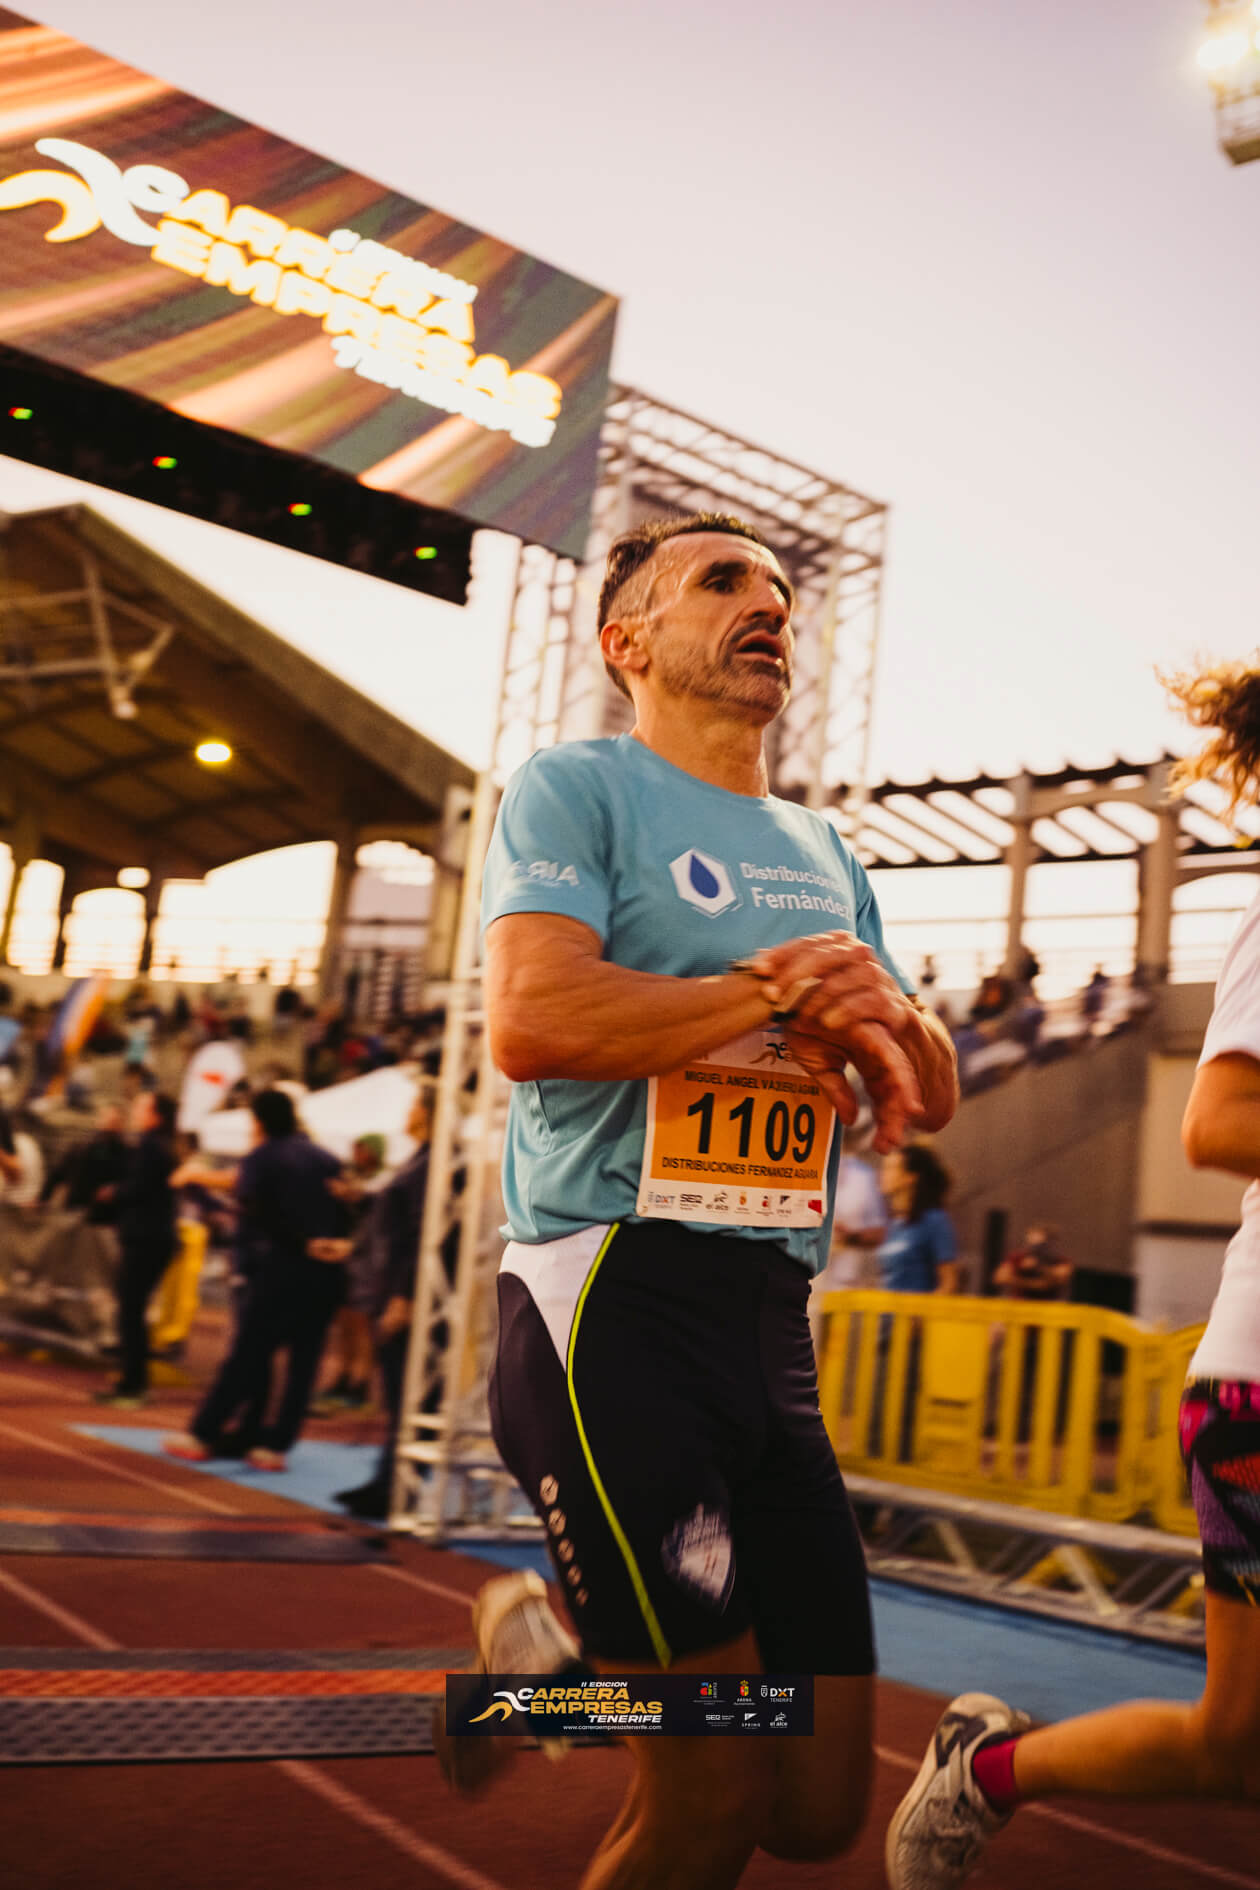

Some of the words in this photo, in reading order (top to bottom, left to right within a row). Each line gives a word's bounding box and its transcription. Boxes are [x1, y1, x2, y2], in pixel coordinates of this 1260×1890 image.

[685, 1070, 724, 1086] MIGUEL
[726, 1075, 759, 1089] ANGEL
[687, 1092, 816, 1164] 1109
[662, 1156, 747, 1176] DISTRIBUCIONES
[747, 1164, 793, 1179] FERNANDEZ
